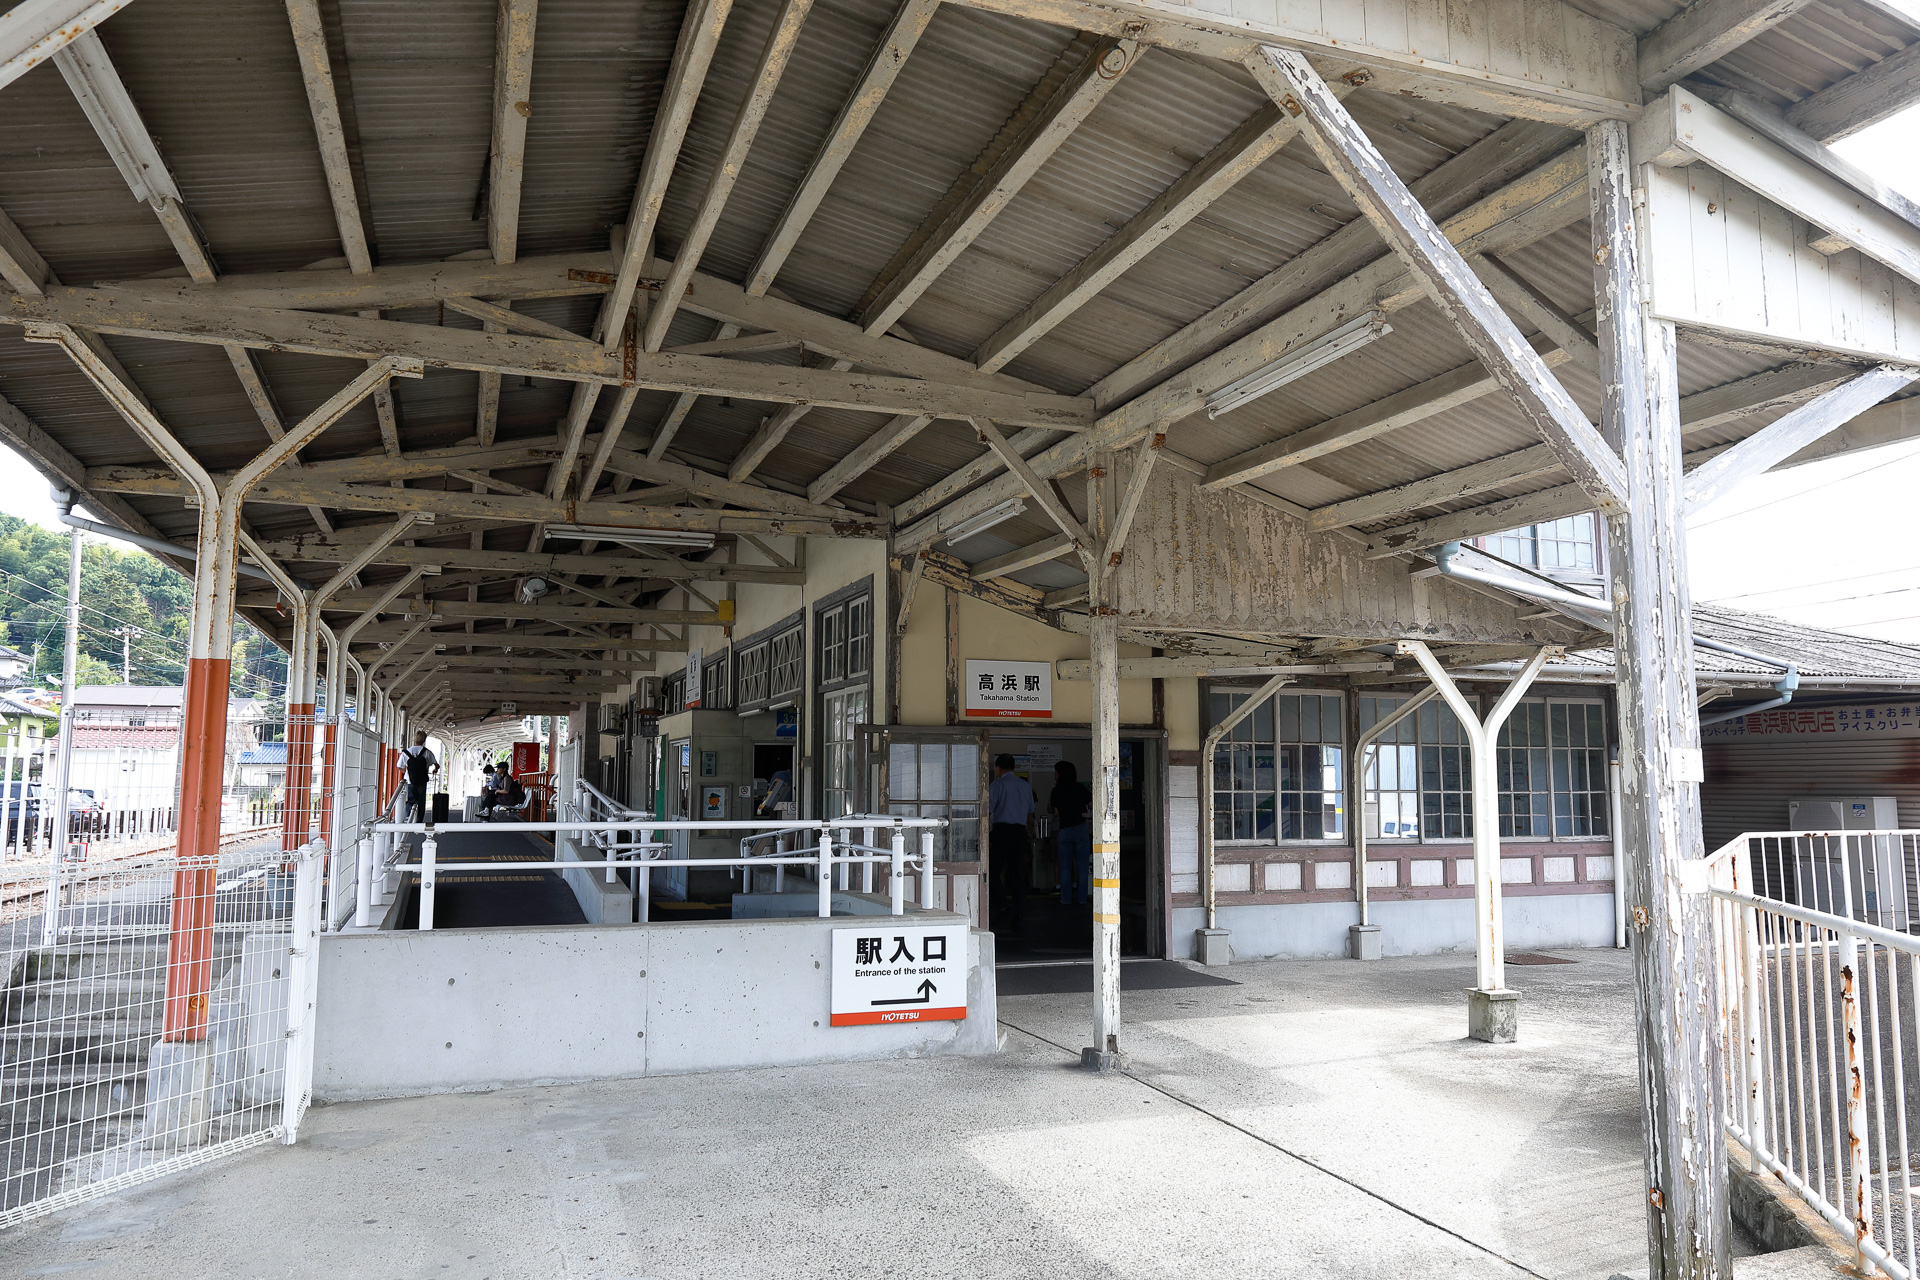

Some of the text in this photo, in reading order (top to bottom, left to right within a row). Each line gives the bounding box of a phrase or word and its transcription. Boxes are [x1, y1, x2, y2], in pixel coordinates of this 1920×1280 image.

[978, 673, 1040, 691] 高浜駅
[1016, 694, 1040, 702] Station
[1746, 710, 1836, 735] 高浜駅売店
[1839, 720, 1920, 731] アイスクリー
[855, 936, 947, 965] 駅入口
[855, 969, 892, 977] Entrance
[918, 966, 946, 974] station
[881, 1012, 920, 1021] IYOTETSU
